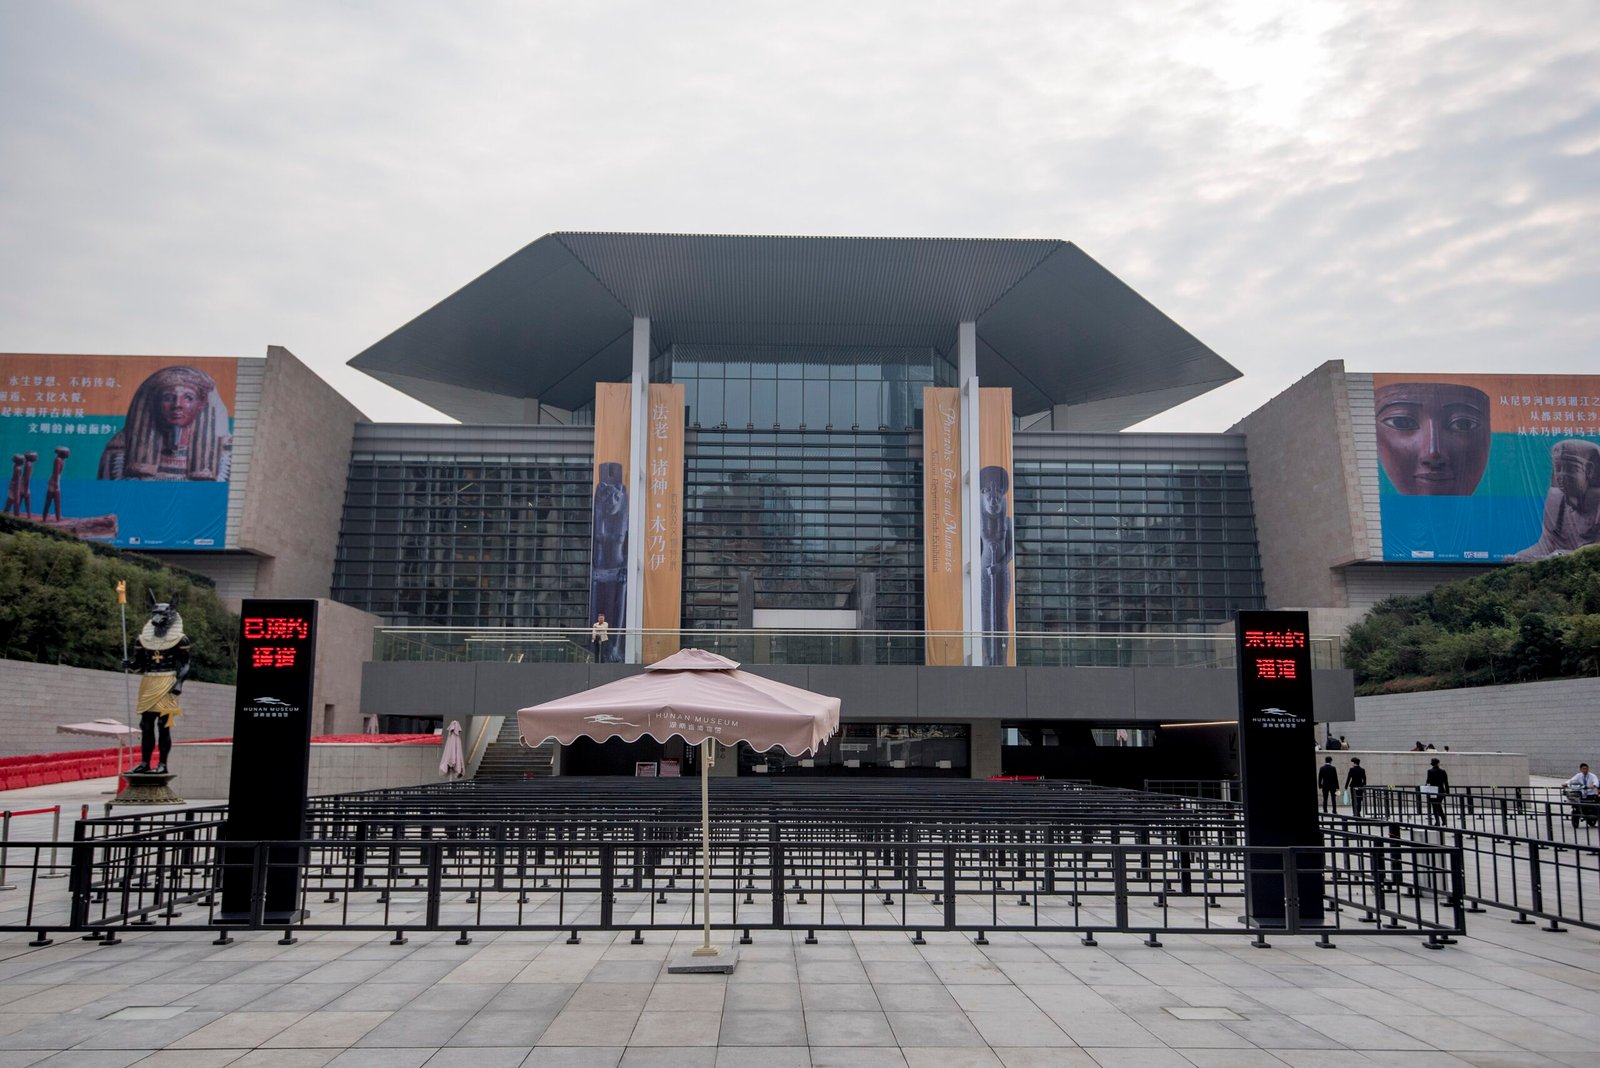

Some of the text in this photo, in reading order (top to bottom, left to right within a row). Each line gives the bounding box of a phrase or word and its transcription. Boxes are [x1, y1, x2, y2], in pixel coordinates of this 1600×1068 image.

[1518, 426, 1600, 437] 从木乃伊到马王
[940, 467, 956, 495] Gods
[944, 498, 955, 516] and
[655, 713, 739, 727] HUNAN MUSEUM
